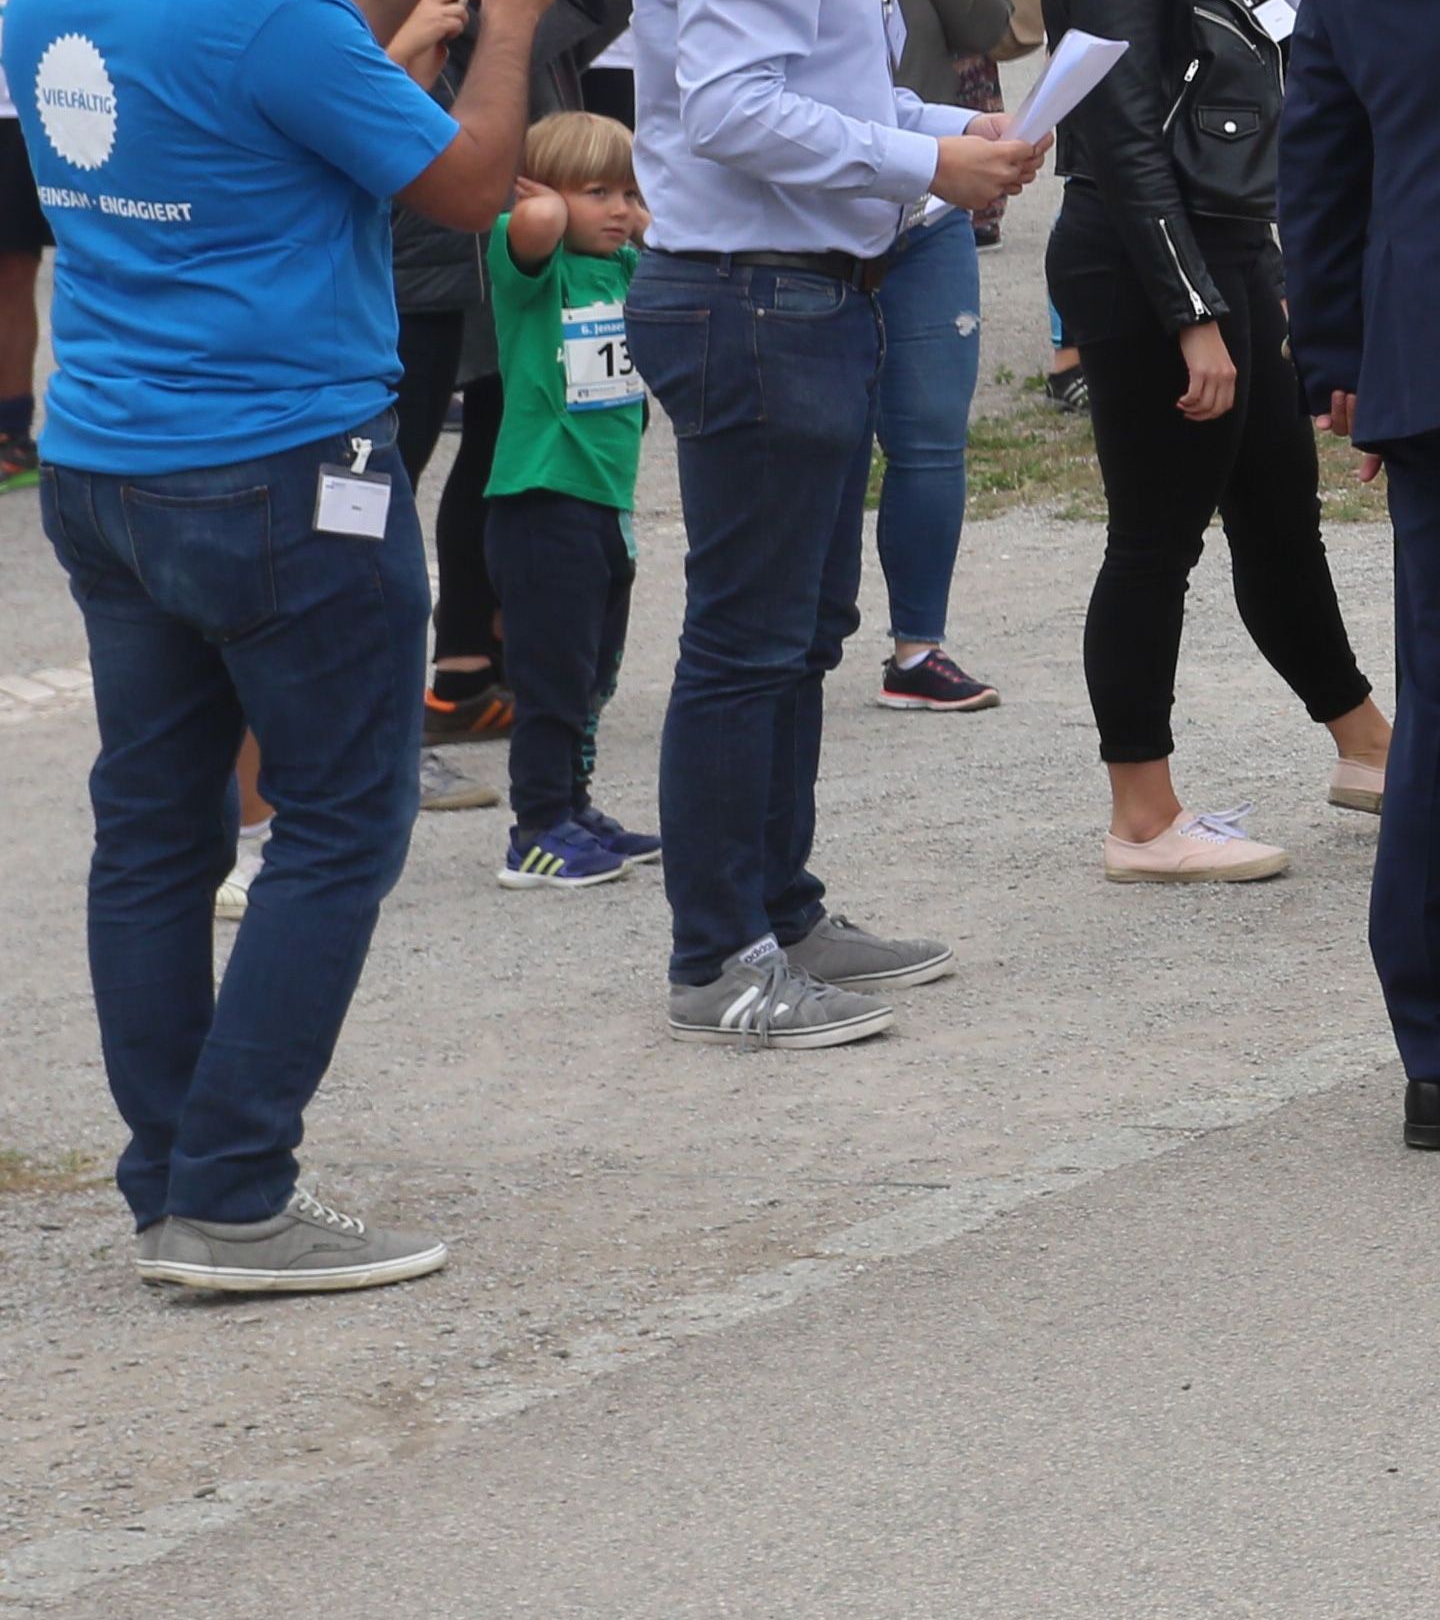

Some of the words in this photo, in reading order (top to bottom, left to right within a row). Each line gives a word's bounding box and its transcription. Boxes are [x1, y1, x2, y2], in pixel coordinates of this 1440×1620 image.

[43, 88, 112, 114] VIELFÄLTIG
[39, 186, 91, 210] EINSAM
[99, 195, 192, 222] ENGAGIERT
